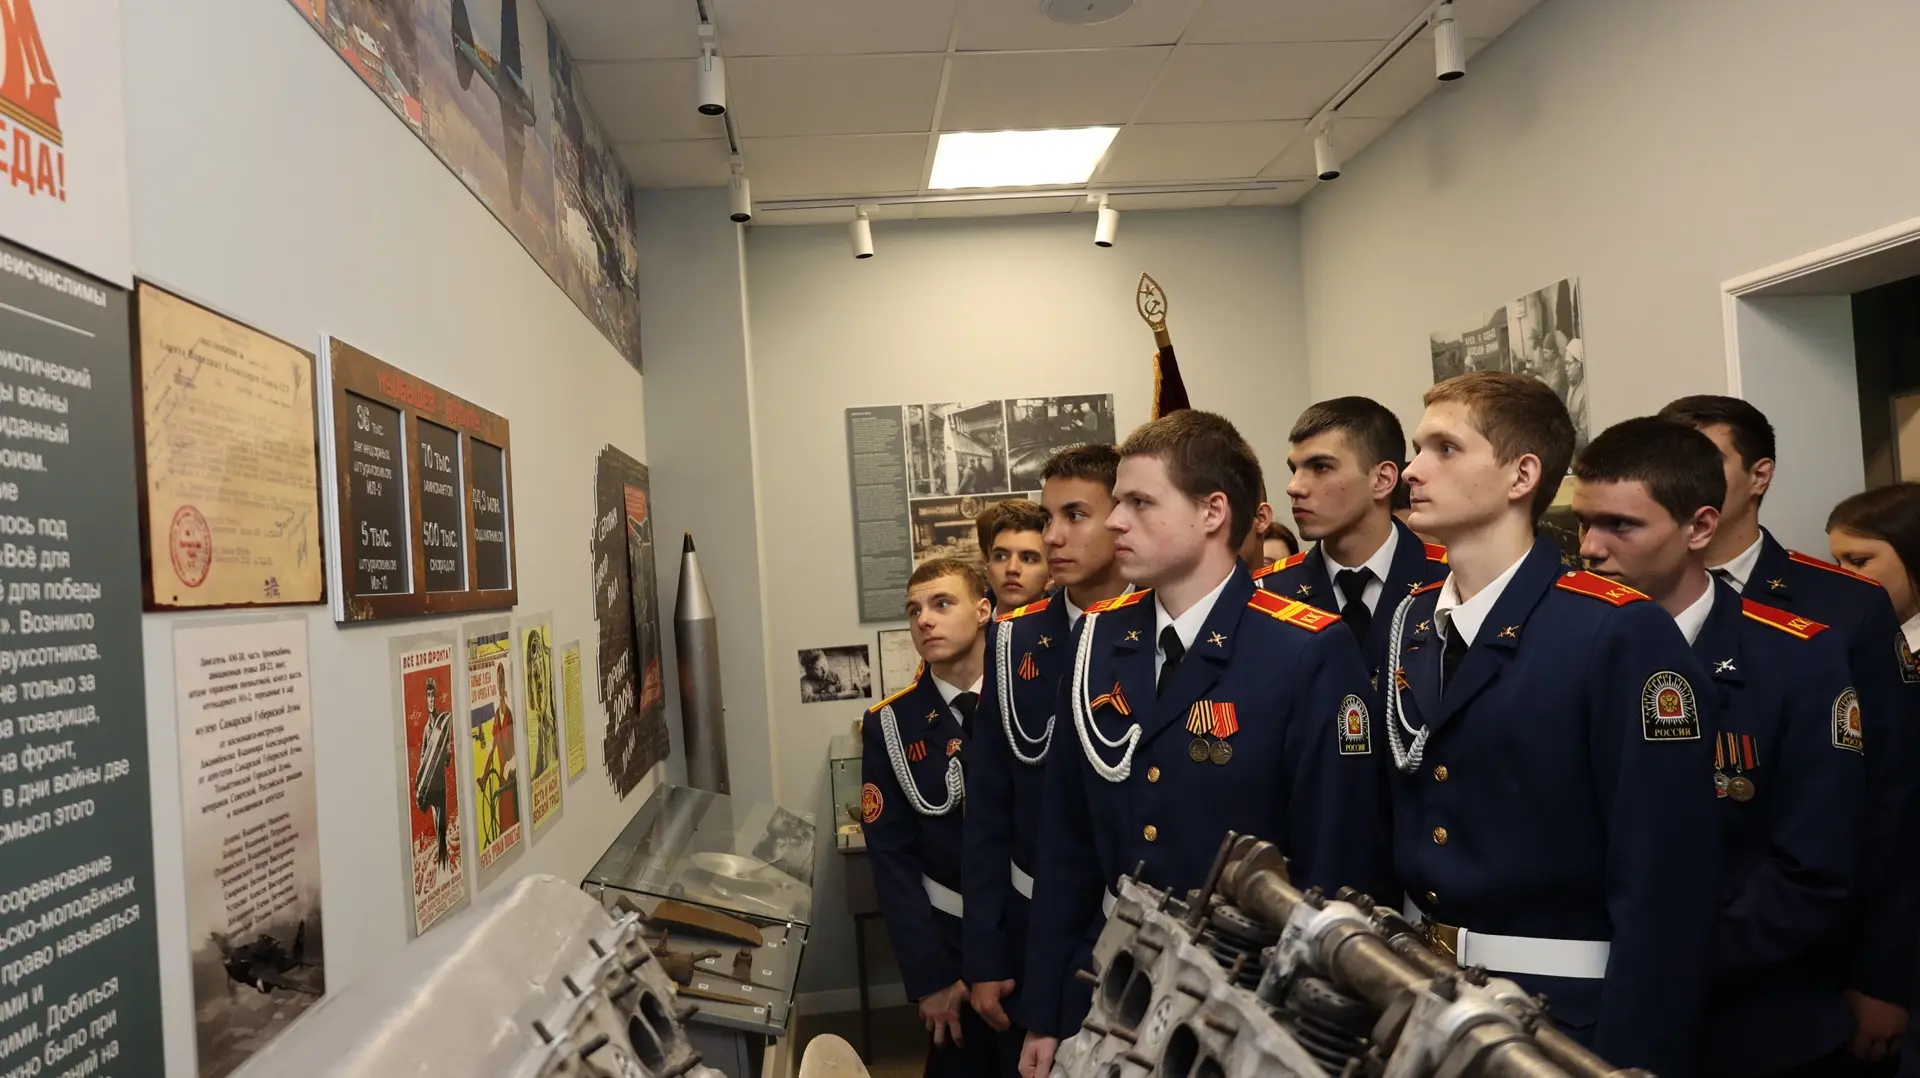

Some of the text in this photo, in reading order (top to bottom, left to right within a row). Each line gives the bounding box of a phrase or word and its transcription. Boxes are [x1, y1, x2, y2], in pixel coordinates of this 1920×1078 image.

[18, 386, 68, 413] войны
[357, 405, 370, 431] 36
[421, 443, 433, 469] 70
[38, 517, 68, 541] под
[361, 521, 369, 546] 5
[423, 522, 439, 547] 500
[40, 549, 70, 572] для
[8, 582, 40, 605] для
[44, 577, 101, 602] победы
[20, 609, 95, 633] Возникло
[0, 643, 101, 675] вухсотников.
[21, 676, 75, 701] только
[78, 674, 96, 692] за
[18, 704, 100, 735] товарища,
[1654, 727, 1691, 737] РОССИИ
[21, 740, 77, 773] фронт,
[2, 758, 130, 809] в дни войны две
[54, 799, 95, 827] этого
[0, 855, 113, 914] соревнование
[1, 904, 140, 987] право называться
[32, 984, 43, 1005] и
[46, 976, 119, 1037] Добиться
[44, 1028, 87, 1066] было
[89, 1009, 117, 1039] при
[101, 1040, 119, 1065] на
